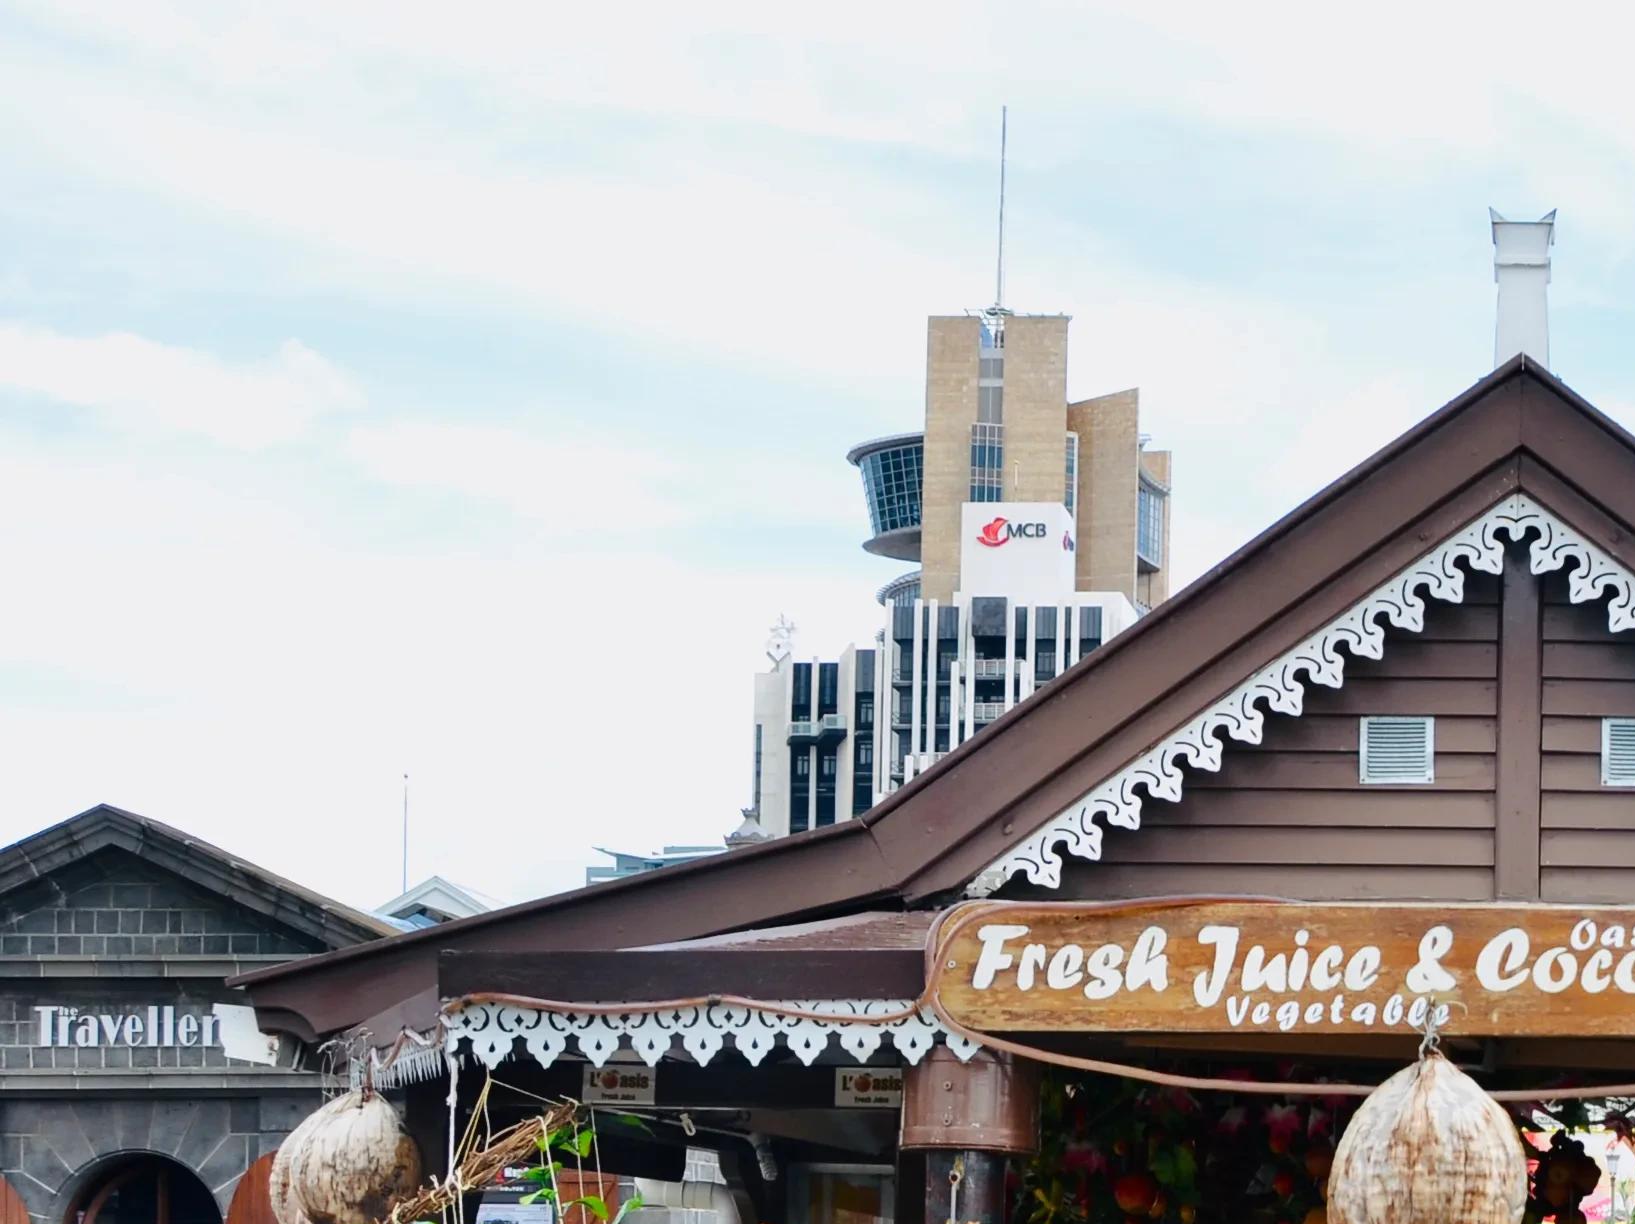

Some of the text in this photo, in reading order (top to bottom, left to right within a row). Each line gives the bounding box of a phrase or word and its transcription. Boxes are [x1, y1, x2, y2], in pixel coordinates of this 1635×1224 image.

[1006, 522, 1047, 538] MCB
[971, 924, 1169, 1000] Fresh
[1192, 924, 1382, 1008] Juice
[1405, 925, 1457, 993] &
